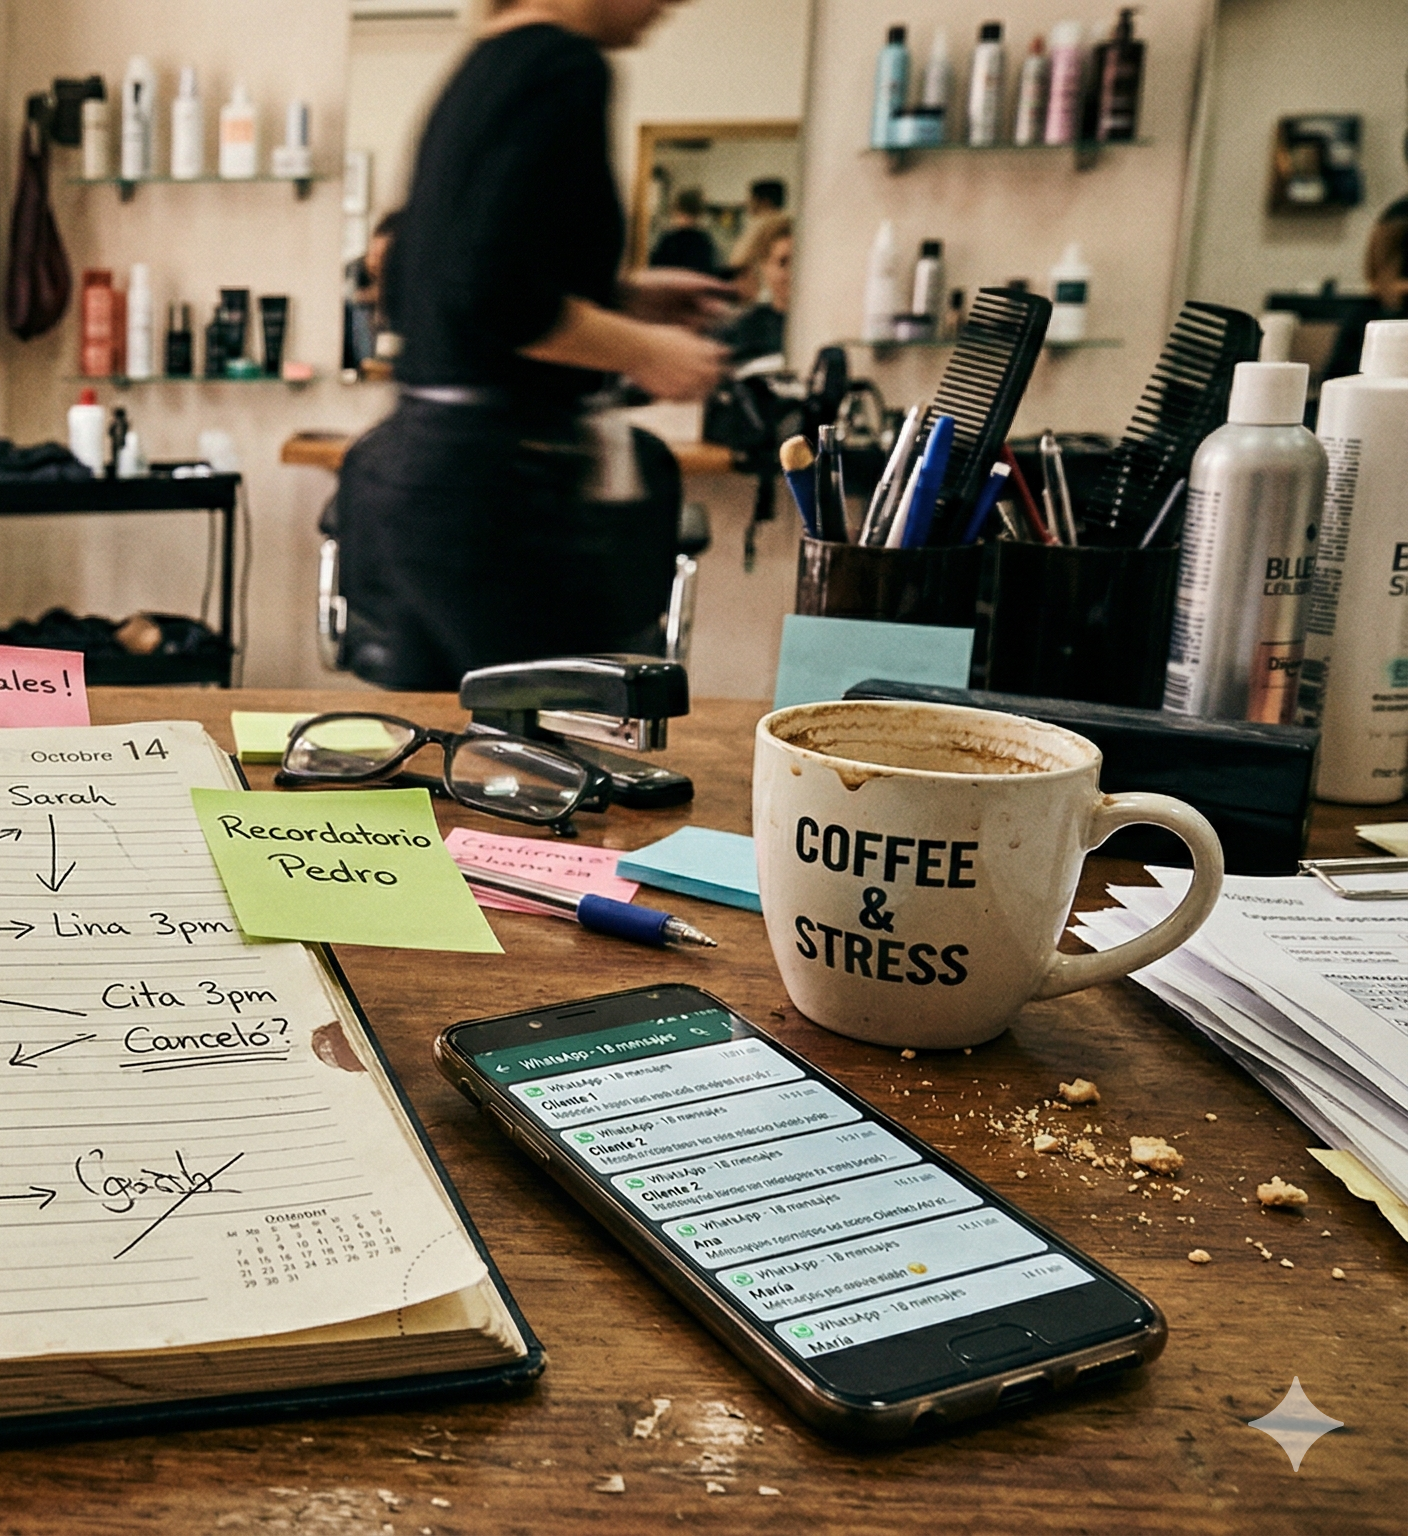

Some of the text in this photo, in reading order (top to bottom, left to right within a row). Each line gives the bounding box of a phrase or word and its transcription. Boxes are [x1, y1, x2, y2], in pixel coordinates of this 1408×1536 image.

[31, 738, 169, 763] Octobre 14
[8, 785, 117, 806] Sarah
[217, 814, 432, 848] Recordatorio
[795, 816, 979, 889] COFFEE
[267, 853, 398, 886] Pedro
[858, 886, 895, 933] &
[53, 912, 233, 944] Lina 3pm
[794, 915, 970, 986] STRESS
[101, 981, 278, 1014] Cita 3pm
[123, 1018, 291, 1054] Canceló?
[518, 1047, 588, 1071] WhatsApp
[547, 1076, 603, 1093] WhatsApp
[541, 1091, 598, 1111] Cliente 1
[596, 1121, 655, 1139] WhatsApp
[588, 1136, 648, 1157] Cliente 2
[647, 1164, 707, 1184] WhatsApp
[641, 1181, 703, 1202] Cliente 2
[699, 1211, 762, 1231] WhatsApp
[693, 1237, 723, 1250] Ana
[755, 1258, 819, 1281] WhatsApp
[749, 1281, 795, 1301] María
[815, 1310, 880, 1332] WhatsApp
[807, 1334, 855, 1354] María
